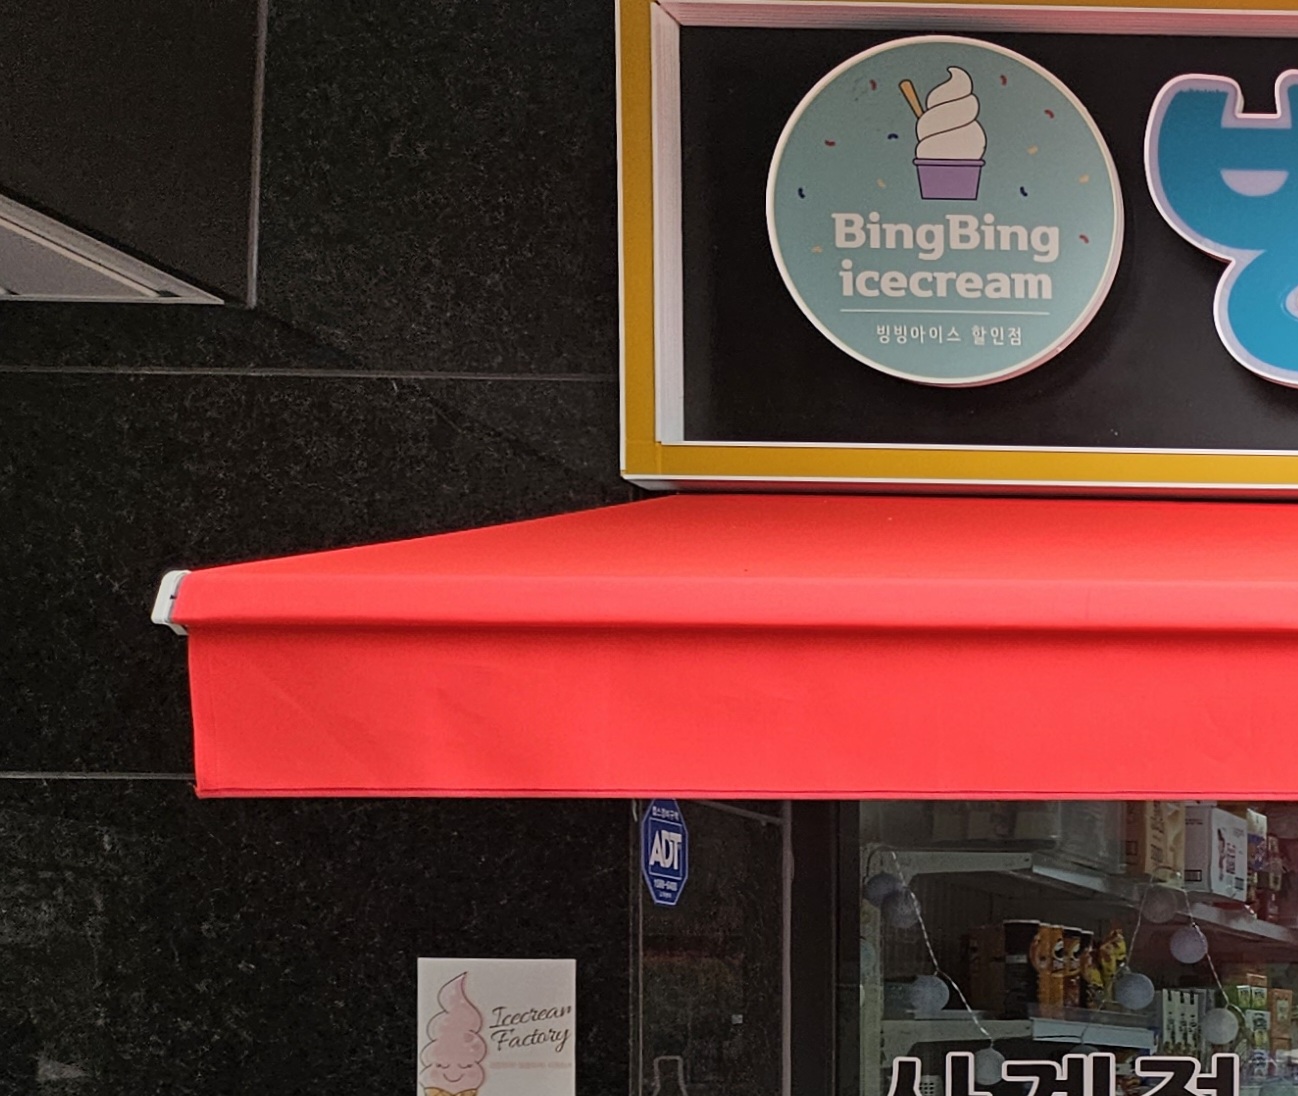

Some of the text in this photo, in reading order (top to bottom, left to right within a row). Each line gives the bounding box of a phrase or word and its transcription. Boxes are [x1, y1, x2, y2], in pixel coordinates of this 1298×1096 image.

[831, 211, 1060, 263] BingBing
[839, 259, 1052, 299] icecream
[876, 324, 1022, 347] 빙빙아이스 할인점
[649, 829, 682, 870] ADT
[490, 1028, 570, 1053] Factory
